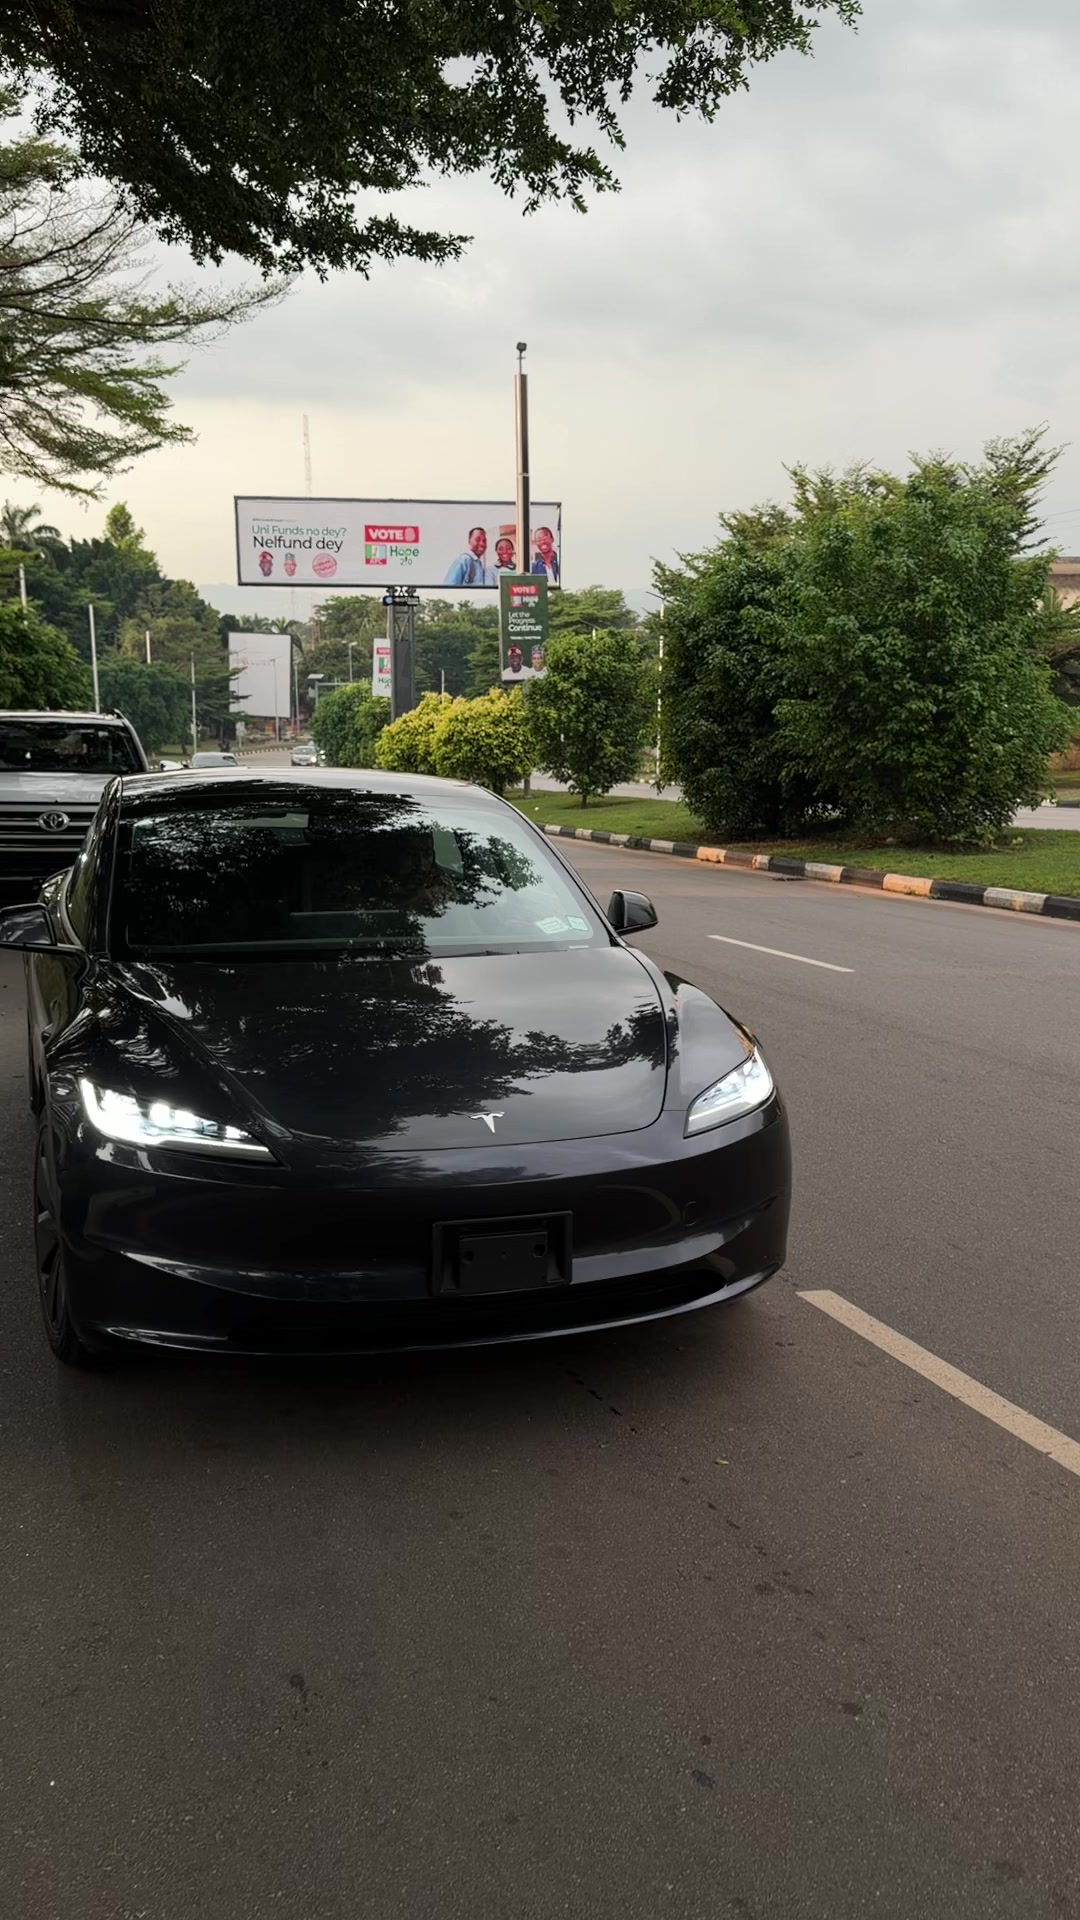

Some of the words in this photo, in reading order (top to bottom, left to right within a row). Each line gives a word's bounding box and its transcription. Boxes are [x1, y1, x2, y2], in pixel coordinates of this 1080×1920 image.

[252, 524, 270, 535] Uni
[272, 525, 304, 536] Funds
[306, 528, 320, 536] no
[322, 527, 347, 539] dey?
[368, 528, 404, 540] VOTE
[253, 535, 312, 549] Nelfund
[316, 537, 344, 553] dey
[390, 545, 420, 560] Hope
[512, 586, 530, 594] VOTE
[508, 617, 536, 625] Progress
[508, 624, 543, 632] Continue
